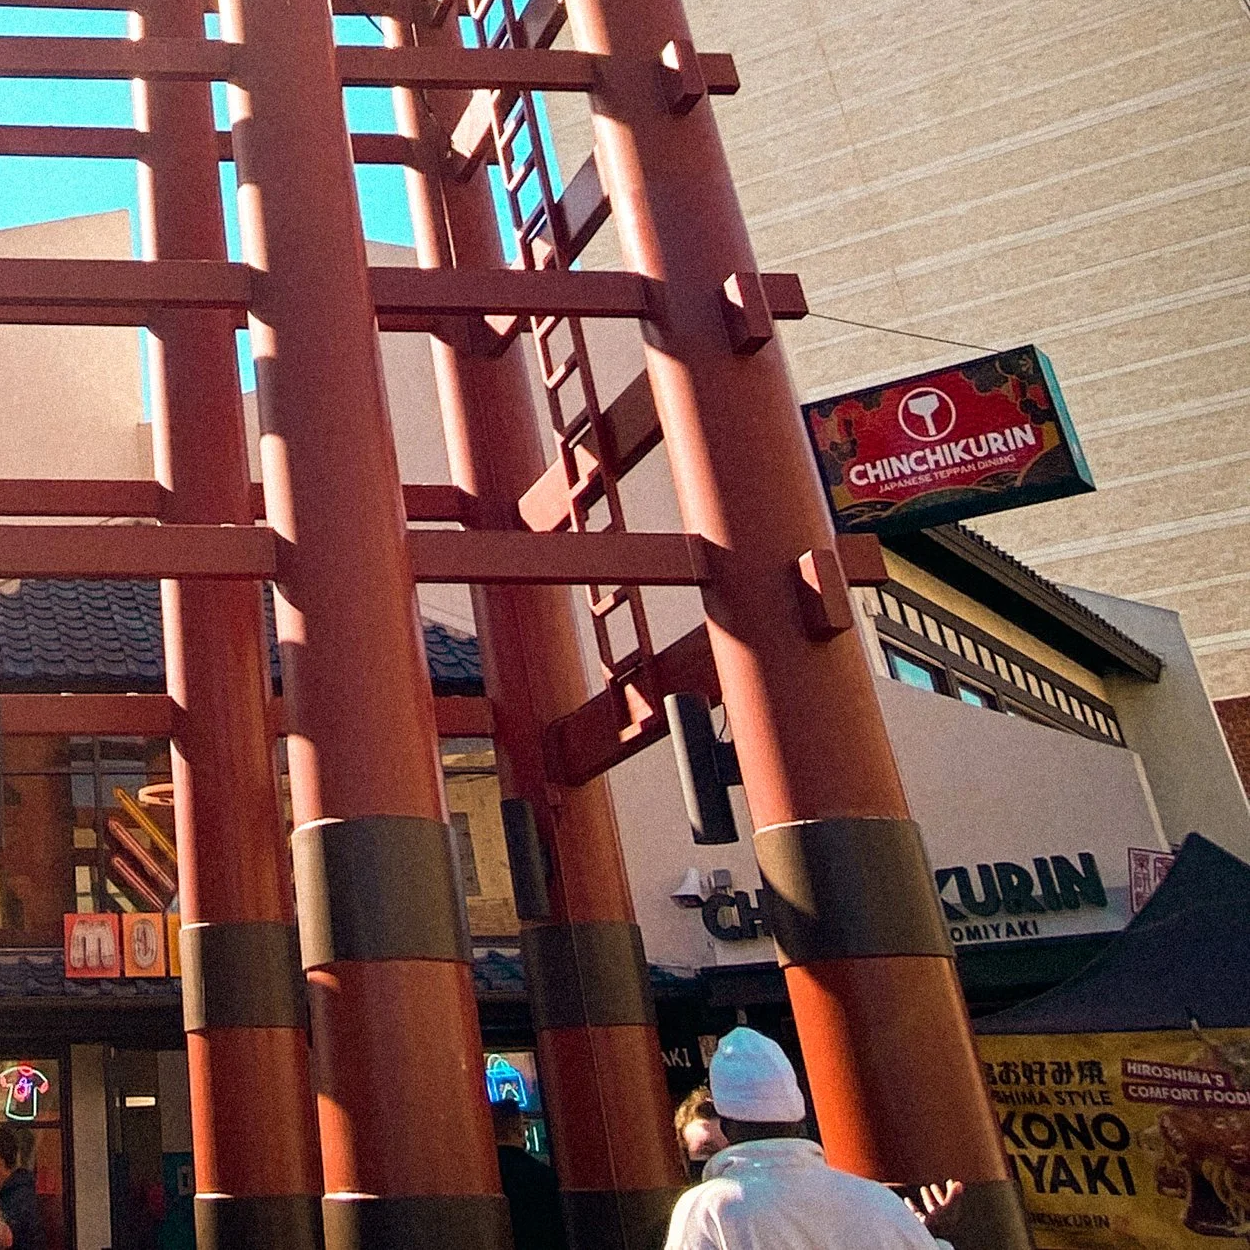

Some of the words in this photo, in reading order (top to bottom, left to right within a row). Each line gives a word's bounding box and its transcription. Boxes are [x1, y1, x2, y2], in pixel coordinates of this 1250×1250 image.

[850, 423, 1036, 487] CHINCHIKURIN
[879, 473, 933, 494] JAPANESE
[933, 463, 977, 482] TEPPAN
[978, 454, 1017, 470] DINING
[1126, 1062, 1226, 1088] HIROSHIMA'S
[1054, 1090, 1114, 1107] STYLE
[1128, 1084, 1200, 1102] COMFORT
